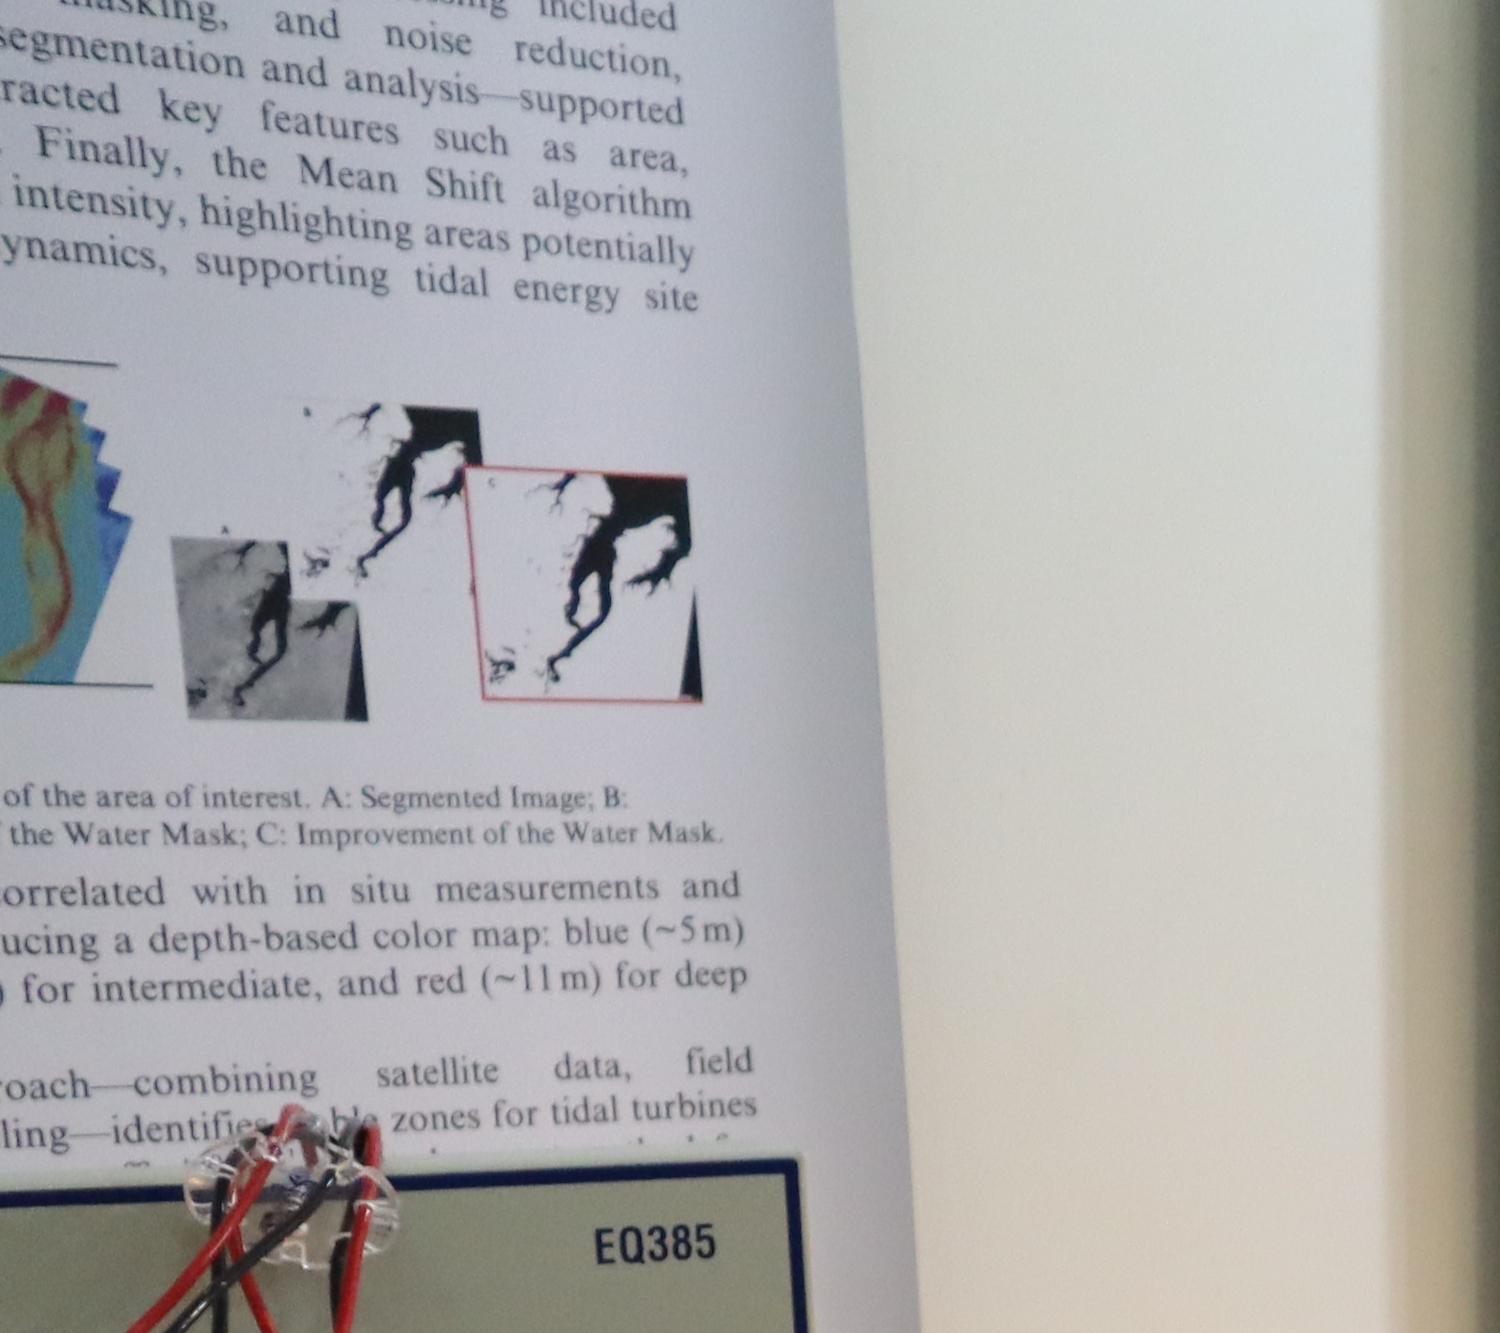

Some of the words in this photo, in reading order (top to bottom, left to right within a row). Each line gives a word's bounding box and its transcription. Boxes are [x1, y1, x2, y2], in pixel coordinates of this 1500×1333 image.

[275, 10, 341, 39] and
[383, 21, 473, 56] noise
[514, 36, 682, 84] reduction,
[262, 57, 329, 88] and
[159, 87, 222, 134] key
[261, 100, 399, 145] features
[434, 125, 509, 156] such
[543, 138, 577, 164] as
[610, 145, 689, 179] area,
[35, 124, 182, 178] Finally,
[213, 147, 267, 181] the
[299, 153, 398, 193] Mean
[426, 166, 504, 203] Shift
[532, 178, 692, 219] algorithm
[12, 173, 187, 228] intensity,
[200, 193, 414, 250] highlighting
[425, 222, 510, 251] areas
[522, 231, 697, 273] potentially
[0, 232, 168, 276] ynamics,
[196, 253, 391, 297] supporting
[415, 262, 490, 297] tidal
[513, 277, 621, 314] energy
[645, 281, 700, 312] site
[3, 782, 34, 808] of
[43, 782, 87, 808] the
[96, 788, 156, 809] area
[165, 783, 196, 808] of
[203, 782, 312, 809] interest.
[321, 786, 352, 808] A:
[361, 785, 500, 814] Segmented
[511, 785, 595, 814] Image;
[603, 786, 629, 808] B:
[10, 821, 54, 846] the
[63, 821, 151, 847] Water
[162, 821, 249, 850] Mask;
[256, 821, 287, 846] C:
[298, 821, 474, 852] Improvement
[483, 820, 510, 845] of
[517, 820, 554, 845] the
[563, 820, 639, 845] Water
[648, 820, 724, 846] Mask.
[194, 874, 267, 905] with
[294, 873, 324, 904] in
[351, 872, 410, 904] situ
[437, 874, 660, 903] measurements
[682, 871, 742, 899] and
[115, 933, 134, 956] a
[149, 920, 359, 961] depth-based
[373, 920, 456, 951] color
[472, 924, 550, 954] map:
[565, 916, 630, 946] blue
[23, 973, 75, 1002] for
[92, 967, 322, 1004] intermediate,
[338, 967, 398, 998] and
[416, 965, 465, 994] red
[616, 960, 662, 989] for
[675, 960, 749, 994] deep
[377, 1054, 500, 1088] satellite
[554, 1052, 632, 1083] data,
[687, 1045, 755, 1076] field
[391, 1106, 481, 1133] zones
[493, 1100, 540, 1128] for
[552, 1094, 619, 1125] tidal
[631, 1091, 758, 1122] turbines
[594, 1223, 717, 1265] EQ385
